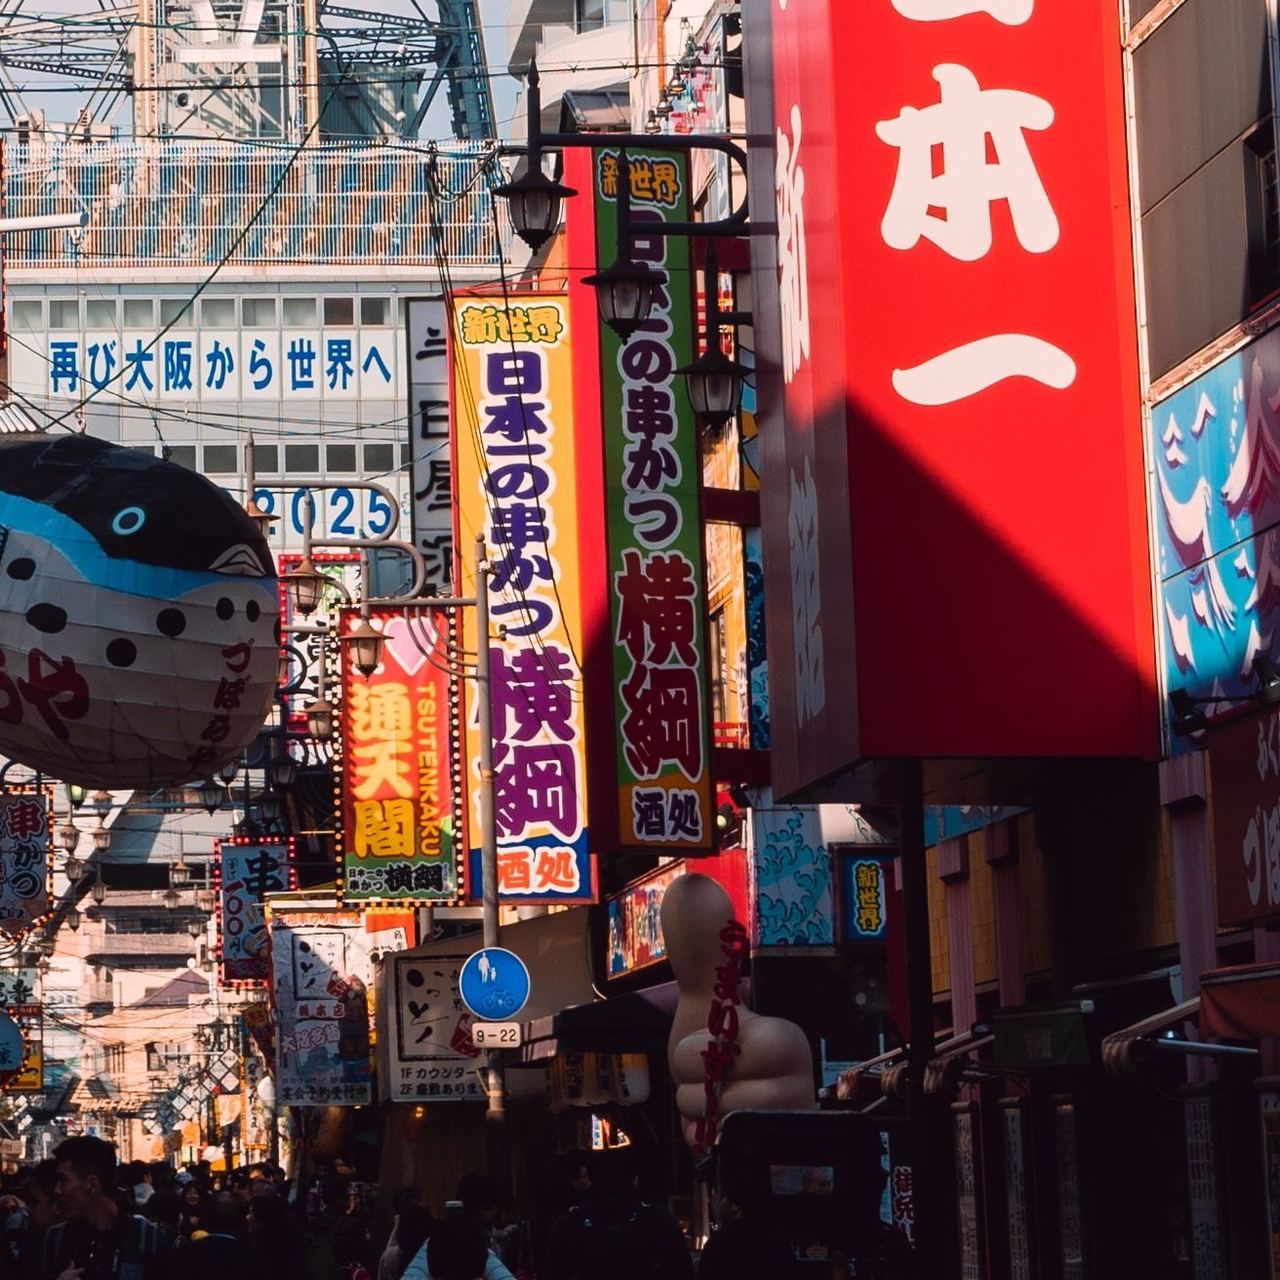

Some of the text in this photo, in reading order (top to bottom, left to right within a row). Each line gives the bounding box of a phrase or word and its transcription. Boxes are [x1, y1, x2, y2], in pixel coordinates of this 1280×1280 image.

[50, 339, 392, 393] 再び大阪から世界へ
[461, 302, 563, 344] 新世界
[485, 351, 553, 639] 日本一の串かつ
[475, 646, 580, 839] 横綱
[617, 551, 703, 780] 横綱
[349, 682, 416, 859] 通天閣
[416, 681, 442, 856] TSUTENKAKU
[632, 788, 703, 841] 酒処
[856, 864, 880, 932] 新世界
